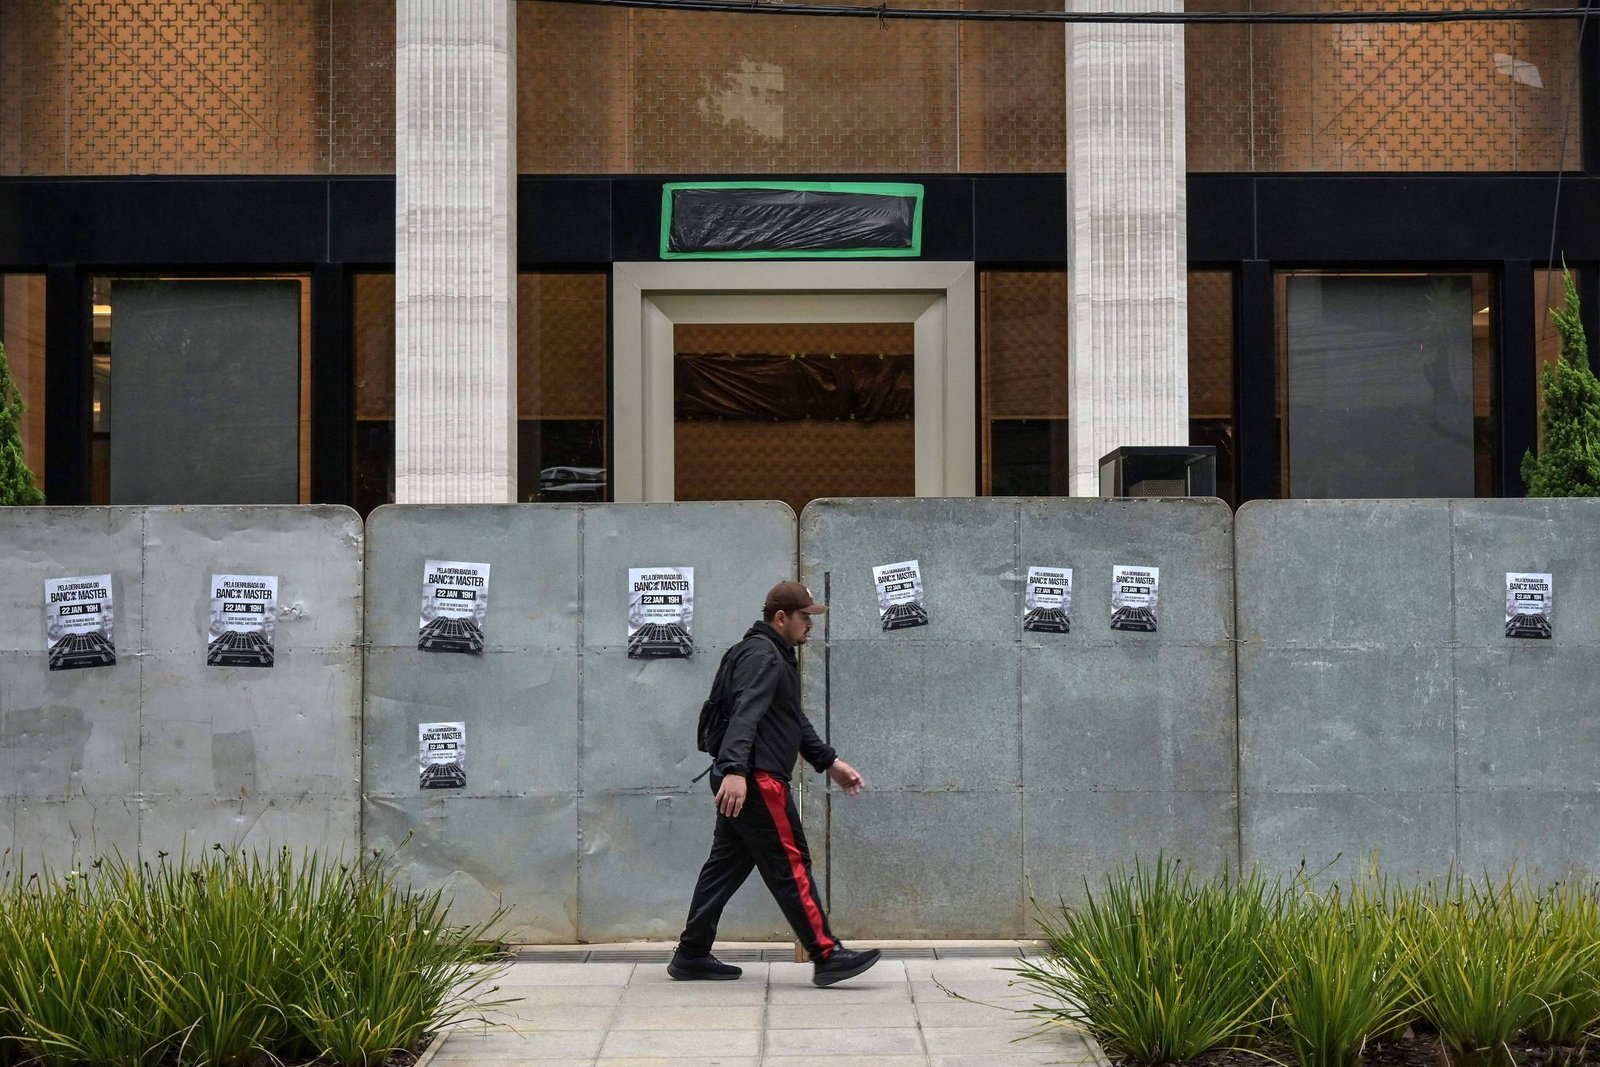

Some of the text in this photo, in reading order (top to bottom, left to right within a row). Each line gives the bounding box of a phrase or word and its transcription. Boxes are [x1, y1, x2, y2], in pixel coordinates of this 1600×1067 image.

[897, 571, 917, 580] MASTER
[456, 576, 484, 587] MASTER
[661, 581, 689, 590] MASTER
[1049, 578, 1068, 586] MASTER
[1135, 577, 1155, 585] MASTER
[68, 582, 93, 590] DERRUBADA
[78, 589, 107, 600] MASTER
[244, 589, 272, 599] MASTER
[446, 590, 457, 598] JAN
[462, 591, 473, 599] 19H
[71, 606, 82, 614] JAN
[86, 604, 98, 612] 19H
[235, 604, 246, 612] JAN
